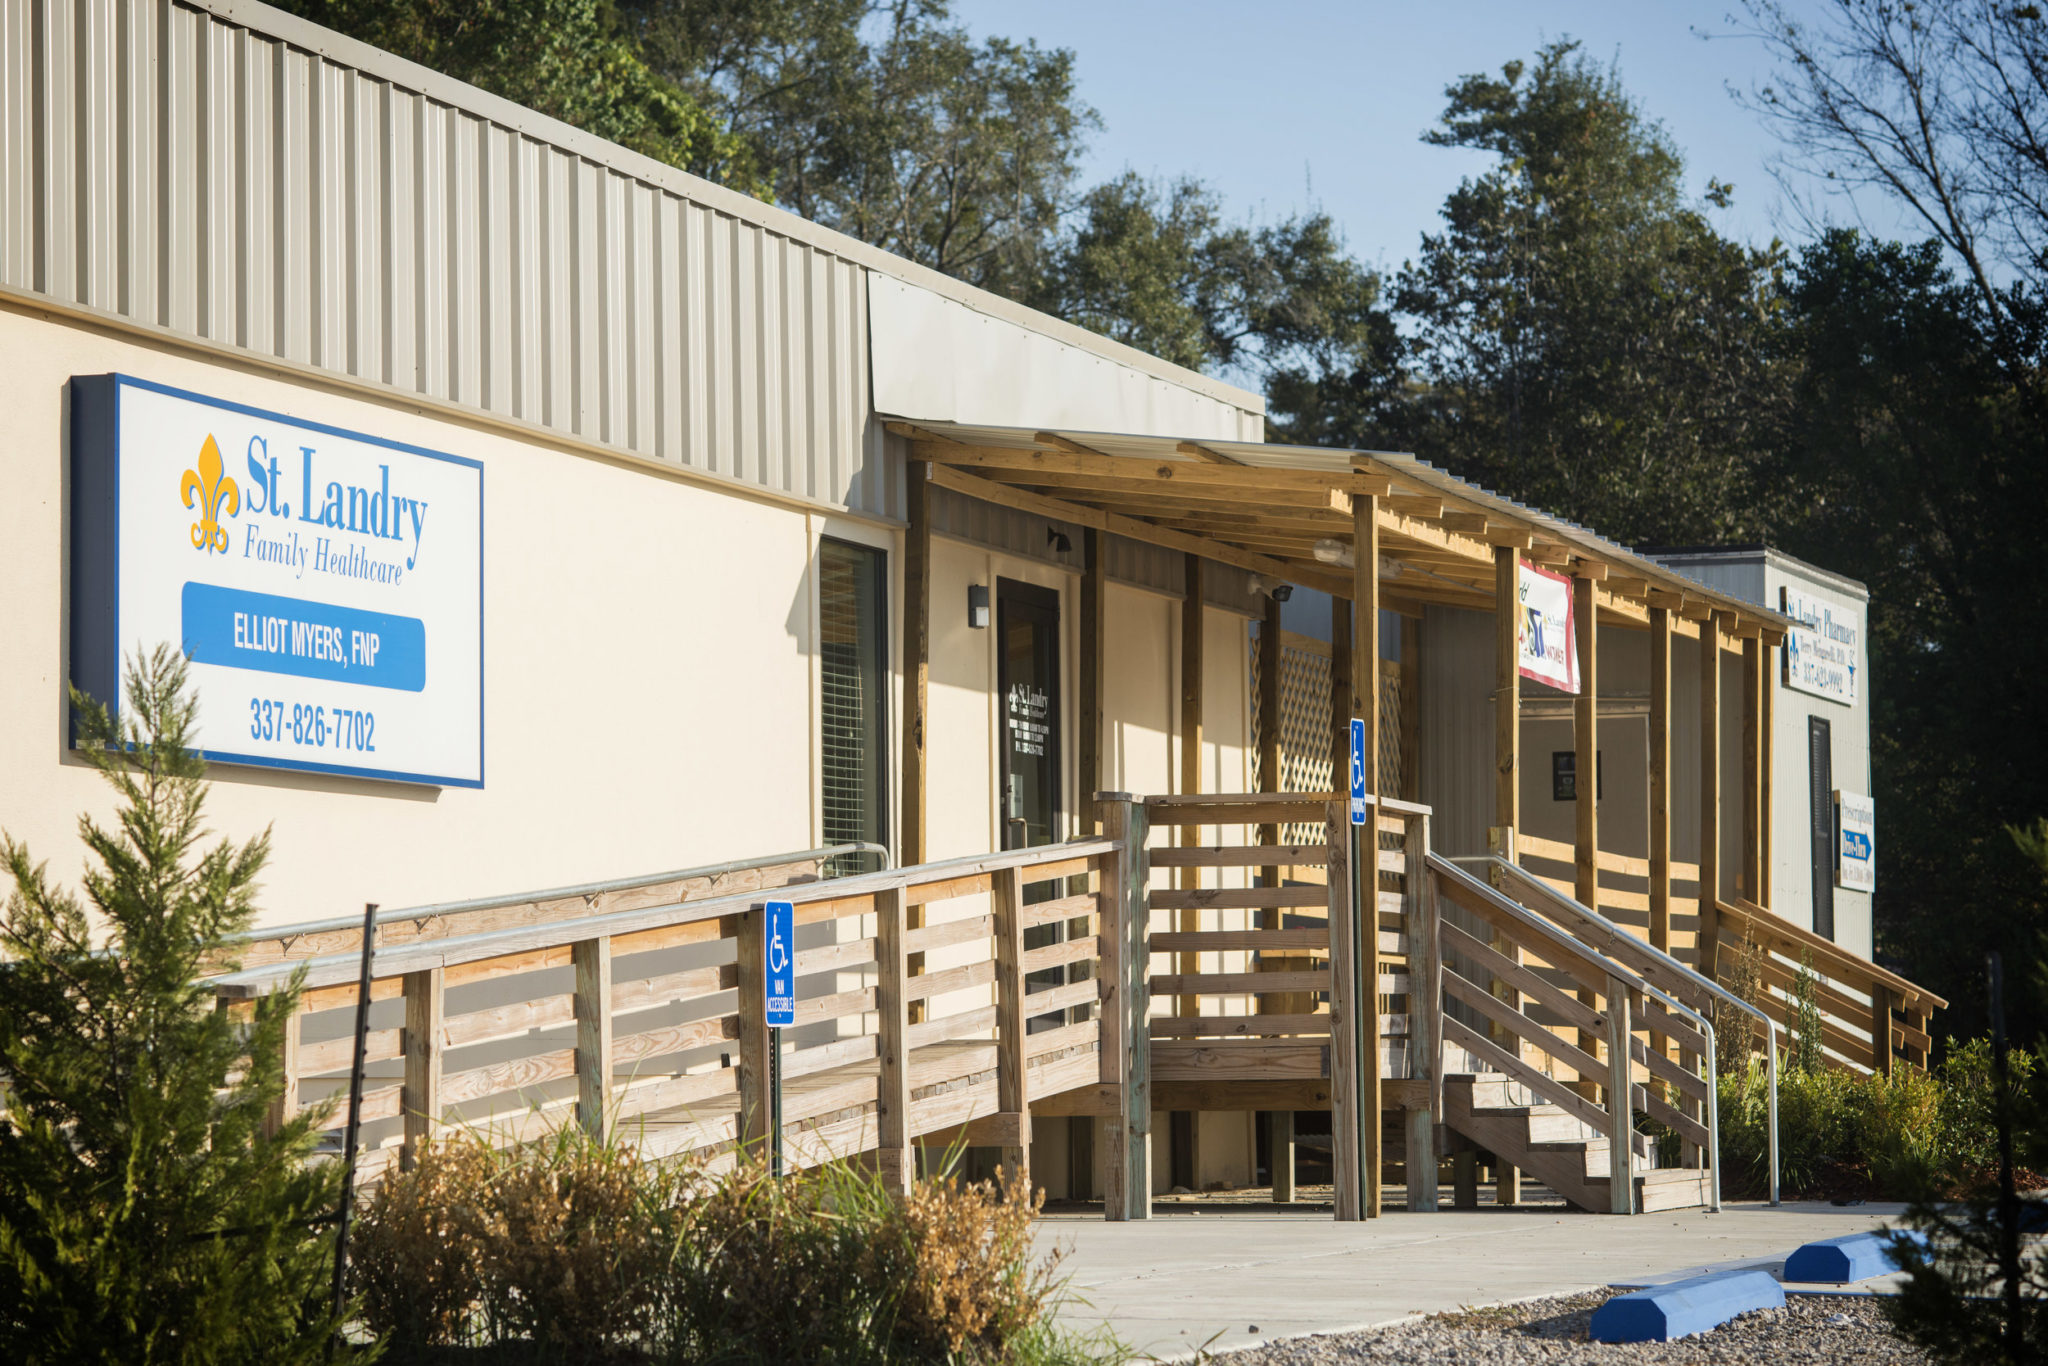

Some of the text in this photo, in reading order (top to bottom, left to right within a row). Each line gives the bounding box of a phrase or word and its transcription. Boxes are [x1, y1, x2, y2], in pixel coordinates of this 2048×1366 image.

[247, 435, 428, 570] St. Landry
[244, 523, 402, 586] Family Healthcare
[233, 612, 380, 669] ELLIOT MYERS, FNP
[1824, 608, 1856, 647] Pharmacy
[1019, 683, 1049, 715] St. Landry
[250, 698, 375, 752] 337-826-7702
[1842, 797, 1873, 828] Prescription
[1842, 832, 1866, 858] Drive-Thru
[775, 979, 785, 994] VAN
[768, 997, 792, 1012] ACCESSIBLE
